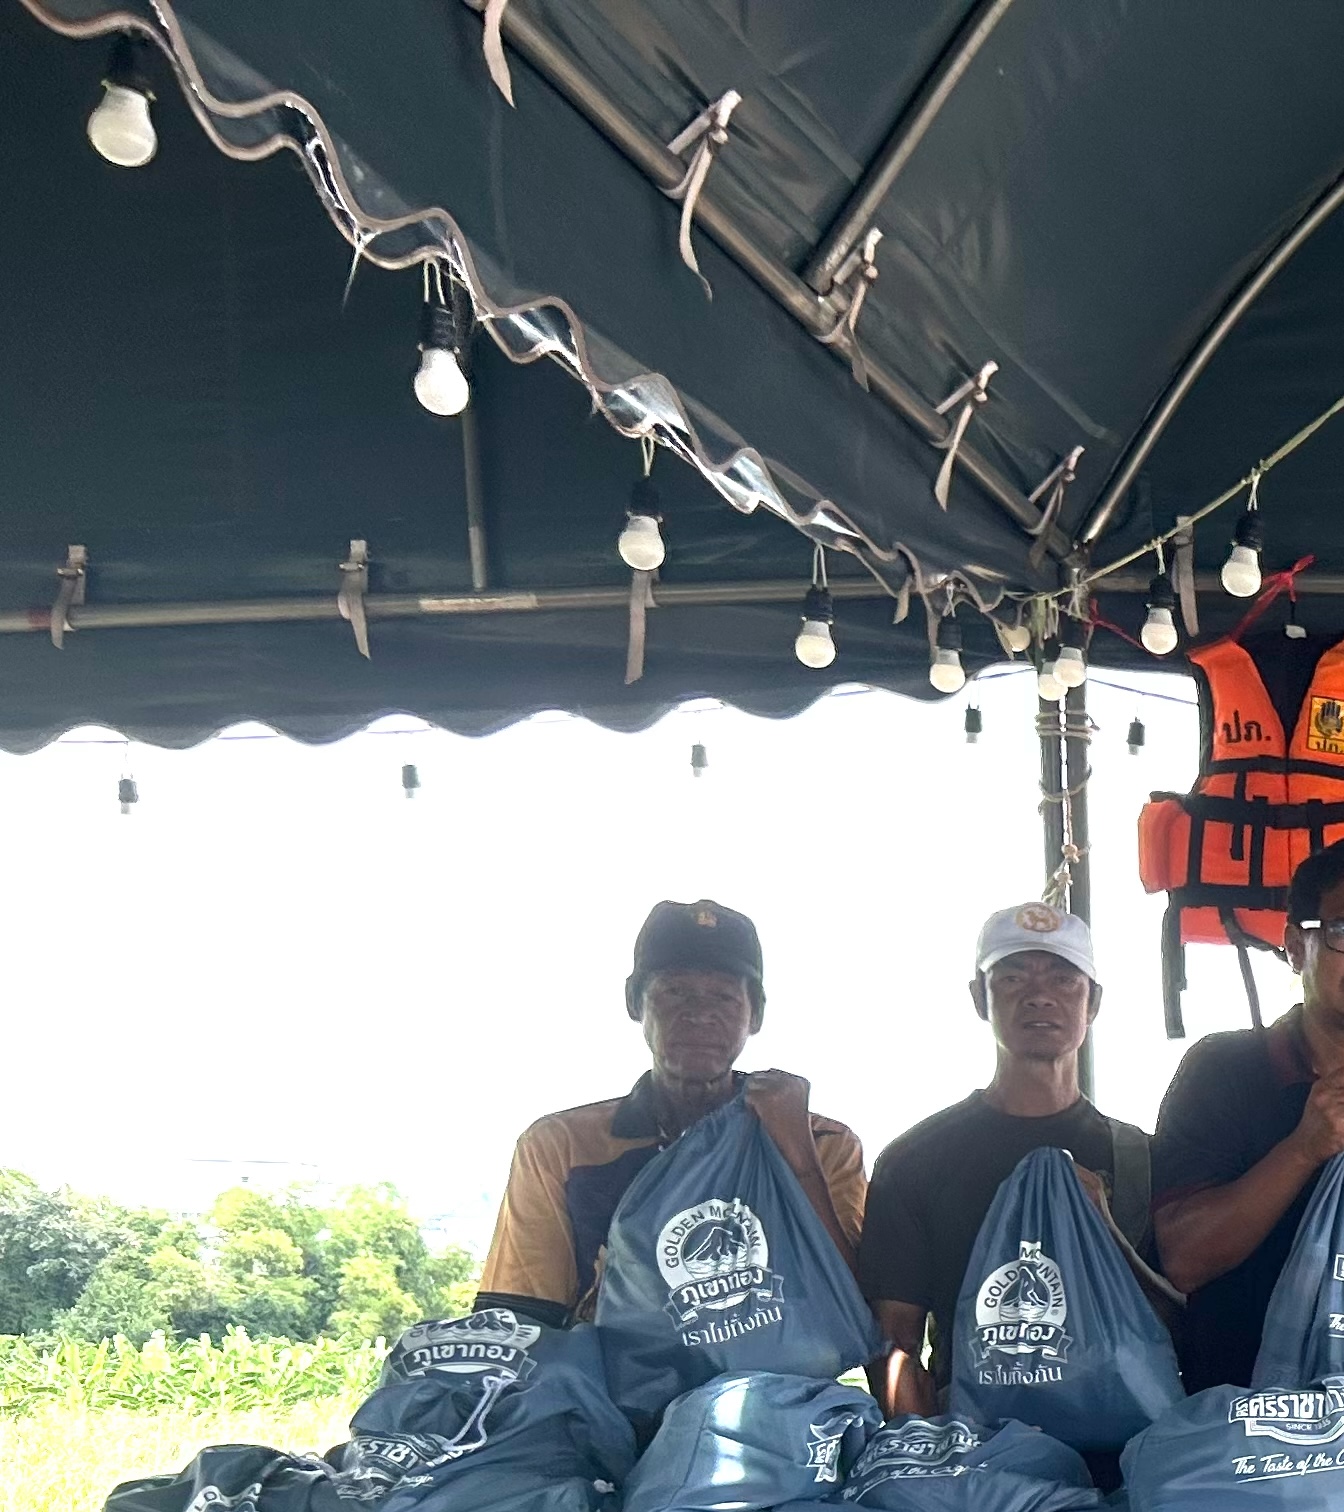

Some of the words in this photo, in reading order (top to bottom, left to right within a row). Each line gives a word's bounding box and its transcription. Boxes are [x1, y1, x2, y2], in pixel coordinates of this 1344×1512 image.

[1223, 709, 1272, 743] ปภ.
[664, 1211, 705, 1269] GOLDEN
[984, 1265, 1020, 1309] GOLD
[413, 1344, 518, 1366] ภูเขาทอง
[1232, 1455, 1256, 1475] The
[1260, 1453, 1294, 1473] Taste
[1296, 1453, 1313, 1475] of
[1313, 1453, 1333, 1468] the
